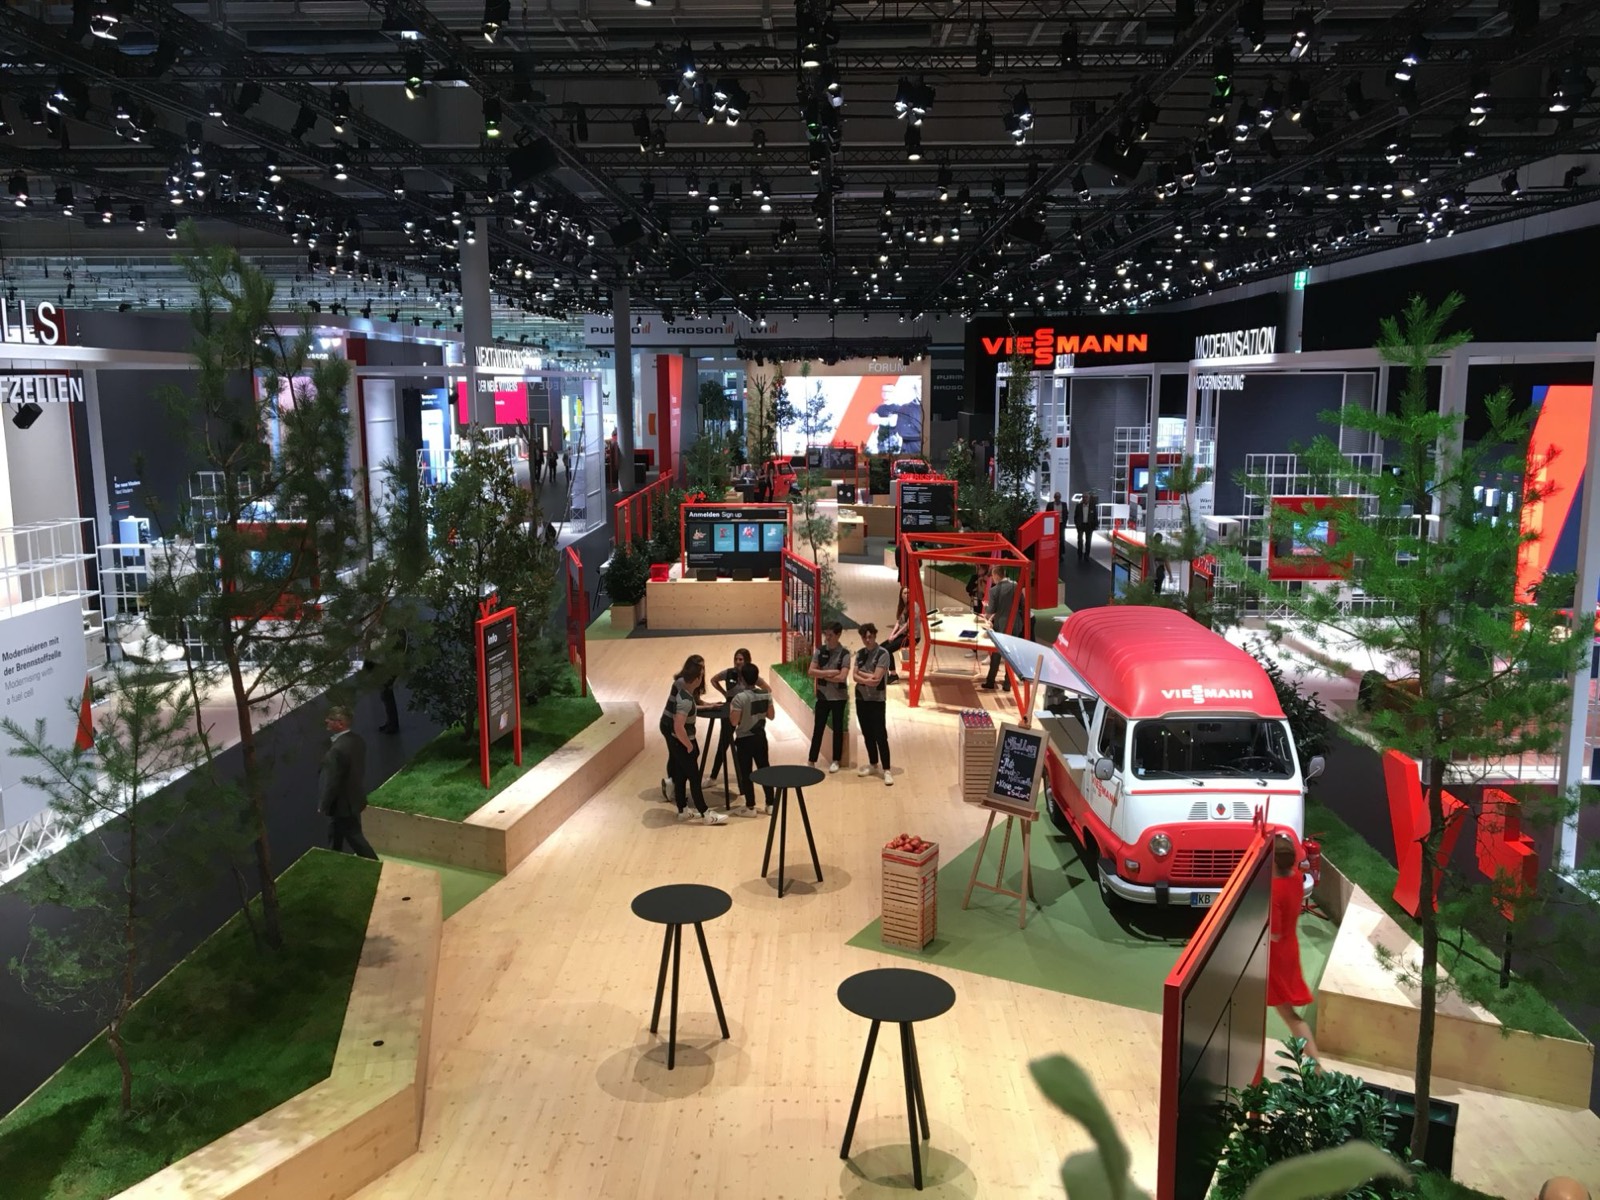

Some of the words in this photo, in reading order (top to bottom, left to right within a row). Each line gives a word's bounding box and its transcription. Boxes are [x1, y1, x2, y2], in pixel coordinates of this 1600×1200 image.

[591, 326, 640, 334] PUO
[667, 326, 723, 334] RADSON
[982, 328, 1148, 365] VIESSMANN
[1195, 326, 1276, 359] MODERNISATION
[868, 362, 907, 372] FORUM
[1194, 374, 1245, 390] MODERNISIERUNG
[487, 633, 498, 645] Info
[2, 641, 47, 661] Modernisieren
[48, 636, 59, 646] mit
[4, 667, 14, 676] der
[16, 650, 61, 672] Brennstoffzelle
[5, 672, 40, 690] Modernising
[24, 687, 34, 699] cell
[1161, 684, 1253, 704] VIESSMANN
[1199, 894, 1211, 905] KB
